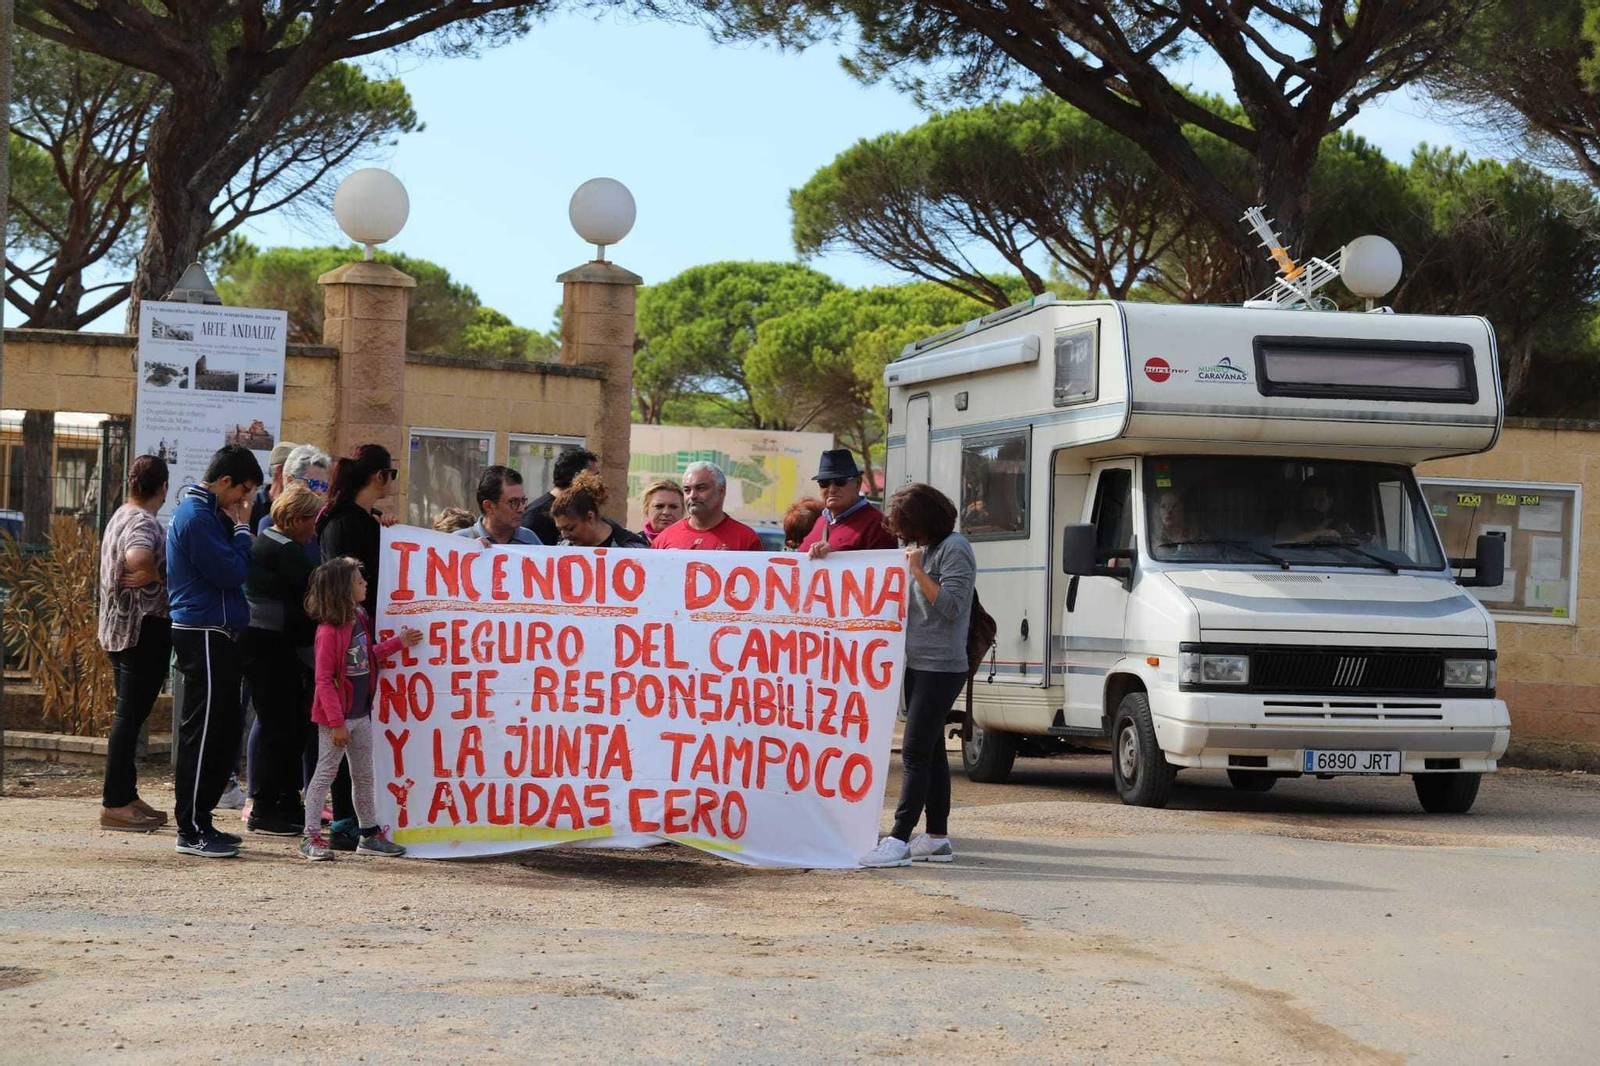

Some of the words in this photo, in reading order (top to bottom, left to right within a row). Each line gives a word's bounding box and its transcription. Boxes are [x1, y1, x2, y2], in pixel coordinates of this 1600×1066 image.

[200, 321, 227, 338] ARTE
[231, 325, 277, 341] ANDALUZ
[1198, 372, 1248, 382] CARAVANAS
[1457, 493, 1481, 504] TAXI
[1521, 495, 1539, 503] TAXI
[685, 558, 906, 621] DOÑANA
[428, 619, 584, 667] SEGURO
[614, 622, 690, 670] DEL
[710, 625, 894, 691] CAMPING
[378, 671, 434, 724] NO
[450, 669, 499, 720] SE
[385, 728, 410, 777] Y
[432, 725, 487, 778] LA
[503, 716, 633, 782] JUNTA
[660, 731, 874, 804] TAMPOCO
[1317, 753, 1357, 769] 6890
[1362, 753, 1392, 770] JRT
[387, 778, 415, 828] Y
[427, 780, 612, 830] AYUDAS
[628, 787, 748, 841] CERO
